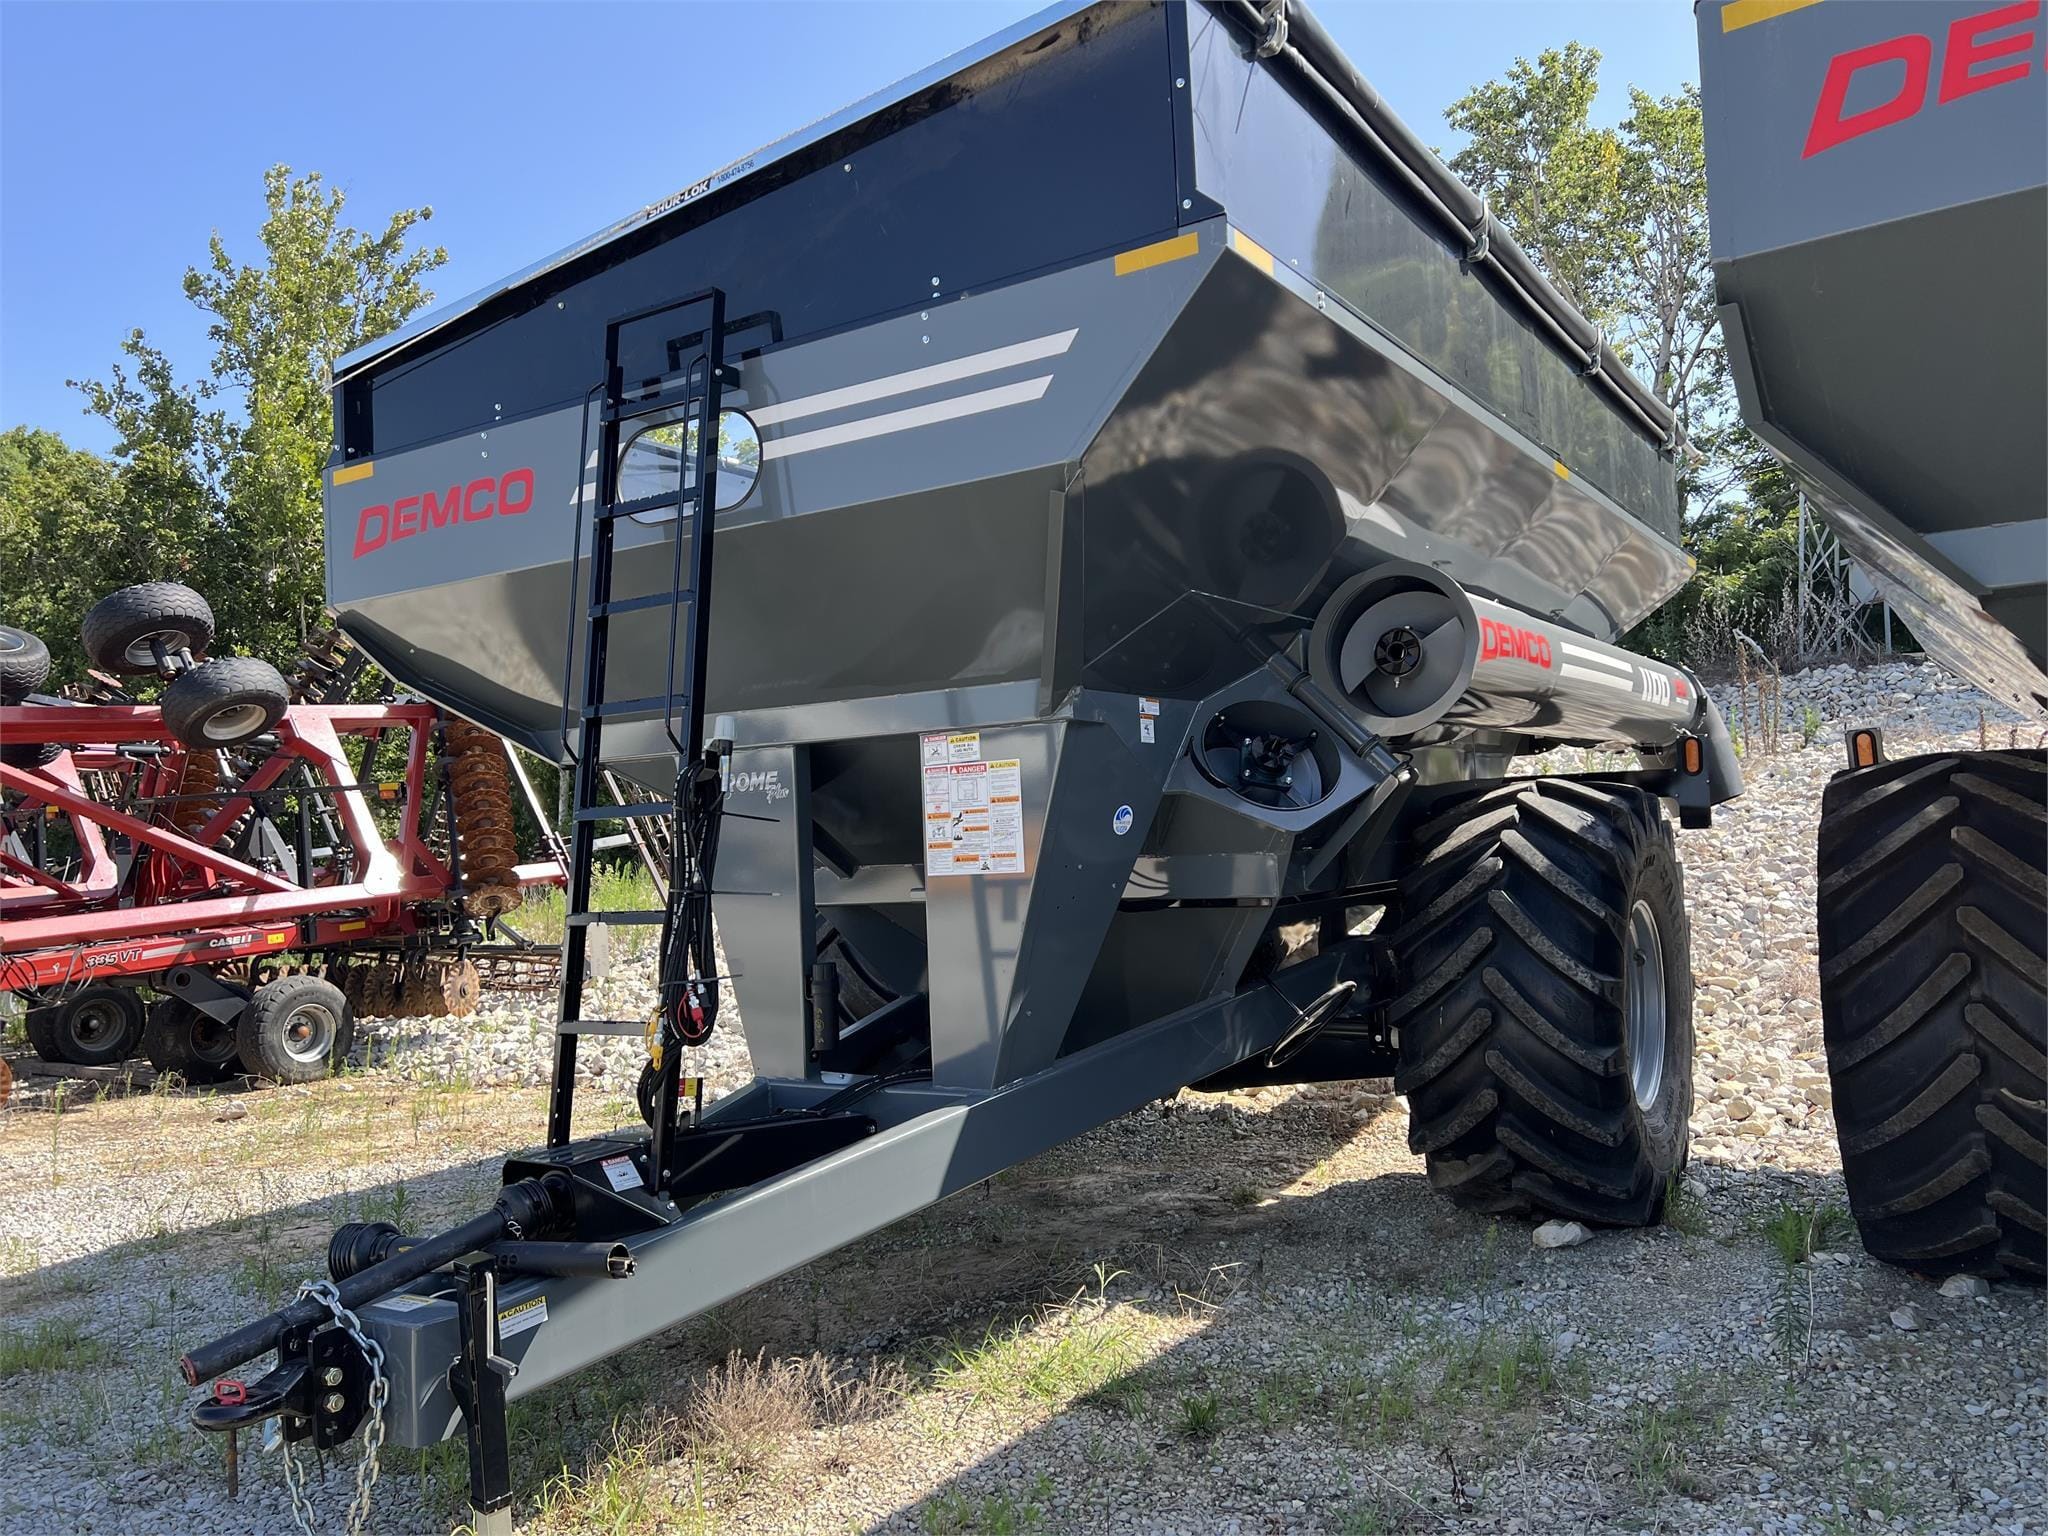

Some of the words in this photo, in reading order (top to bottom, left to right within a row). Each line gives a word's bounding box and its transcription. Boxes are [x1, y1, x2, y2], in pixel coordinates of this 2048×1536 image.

[648, 180, 709, 218] SHUR-LOK
[353, 467, 535, 560] DEMCO
[1479, 616, 1553, 669] DEMCO
[955, 735, 977, 743] CAUTION
[959, 765, 985, 774] DANGER
[209, 935, 242, 947] CASE
[87, 952, 118, 968] 335
[120, 949, 142, 962] VT
[507, 1297, 544, 1317] CAUTION
